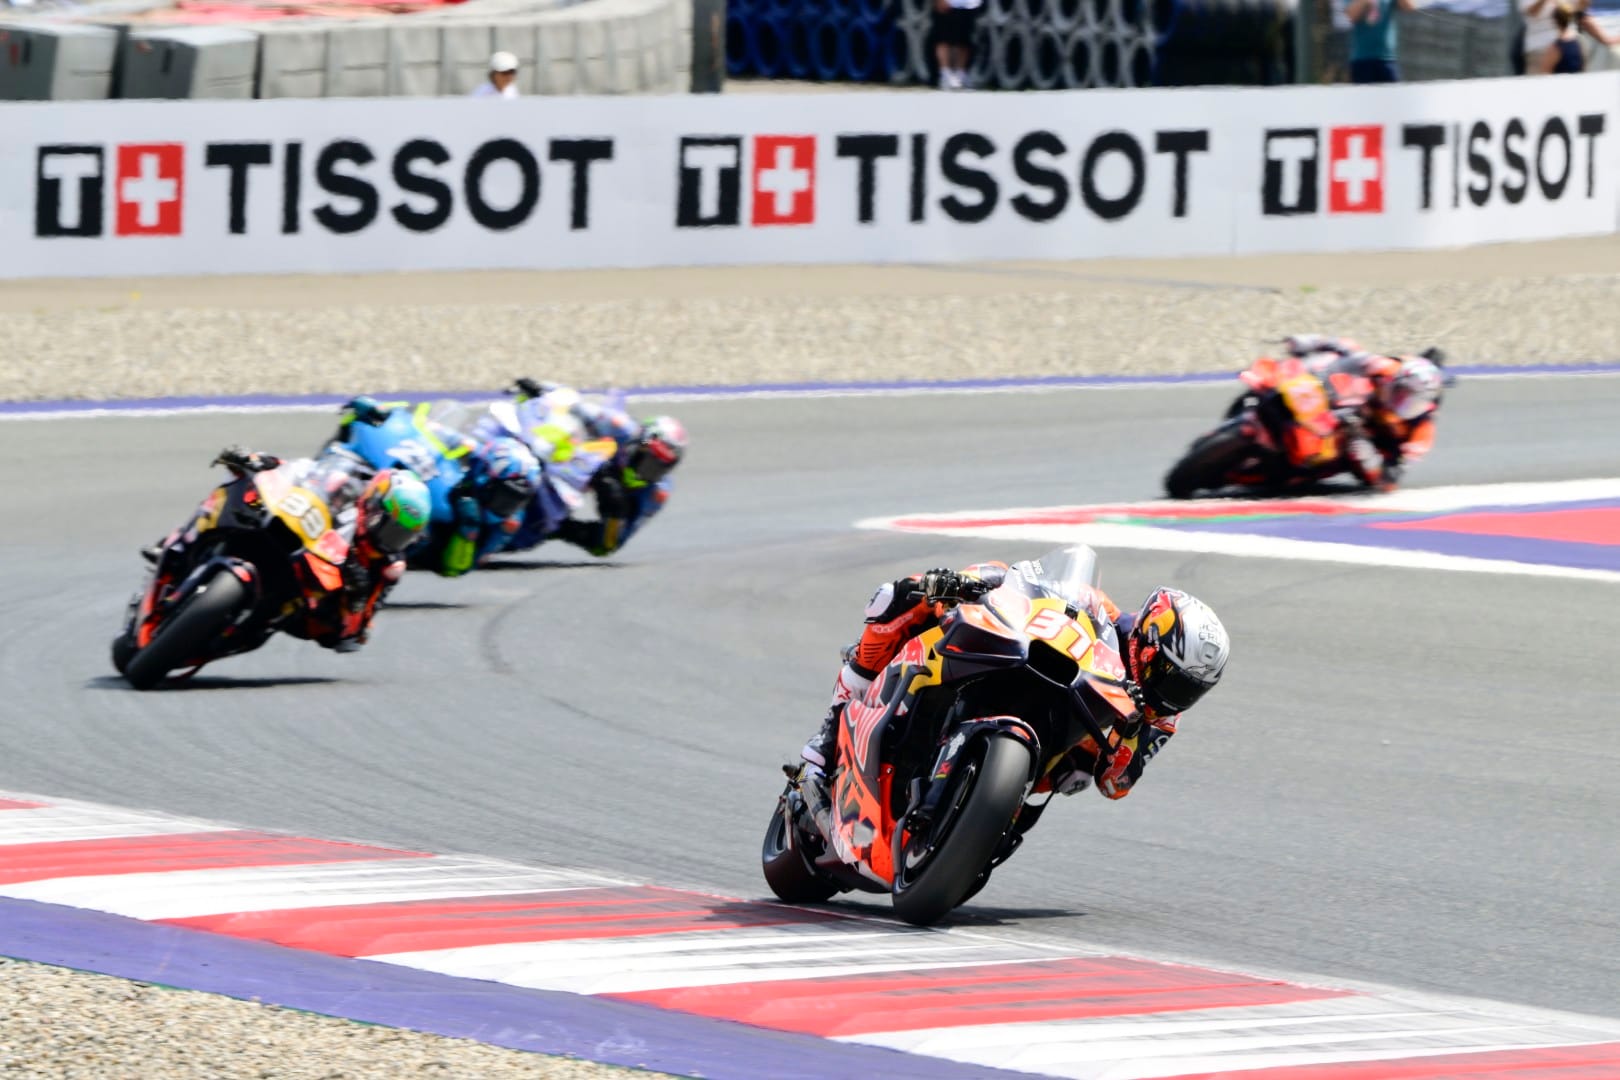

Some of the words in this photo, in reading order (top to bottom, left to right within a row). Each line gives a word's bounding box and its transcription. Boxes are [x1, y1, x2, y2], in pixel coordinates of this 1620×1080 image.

[42, 153, 100, 228] T
[205, 138, 615, 236] TISSOT
[683, 145, 738, 219] T
[834, 129, 1210, 224] TISSOT
[1267, 137, 1316, 208] T
[1401, 114, 1605, 210] TISSOT
